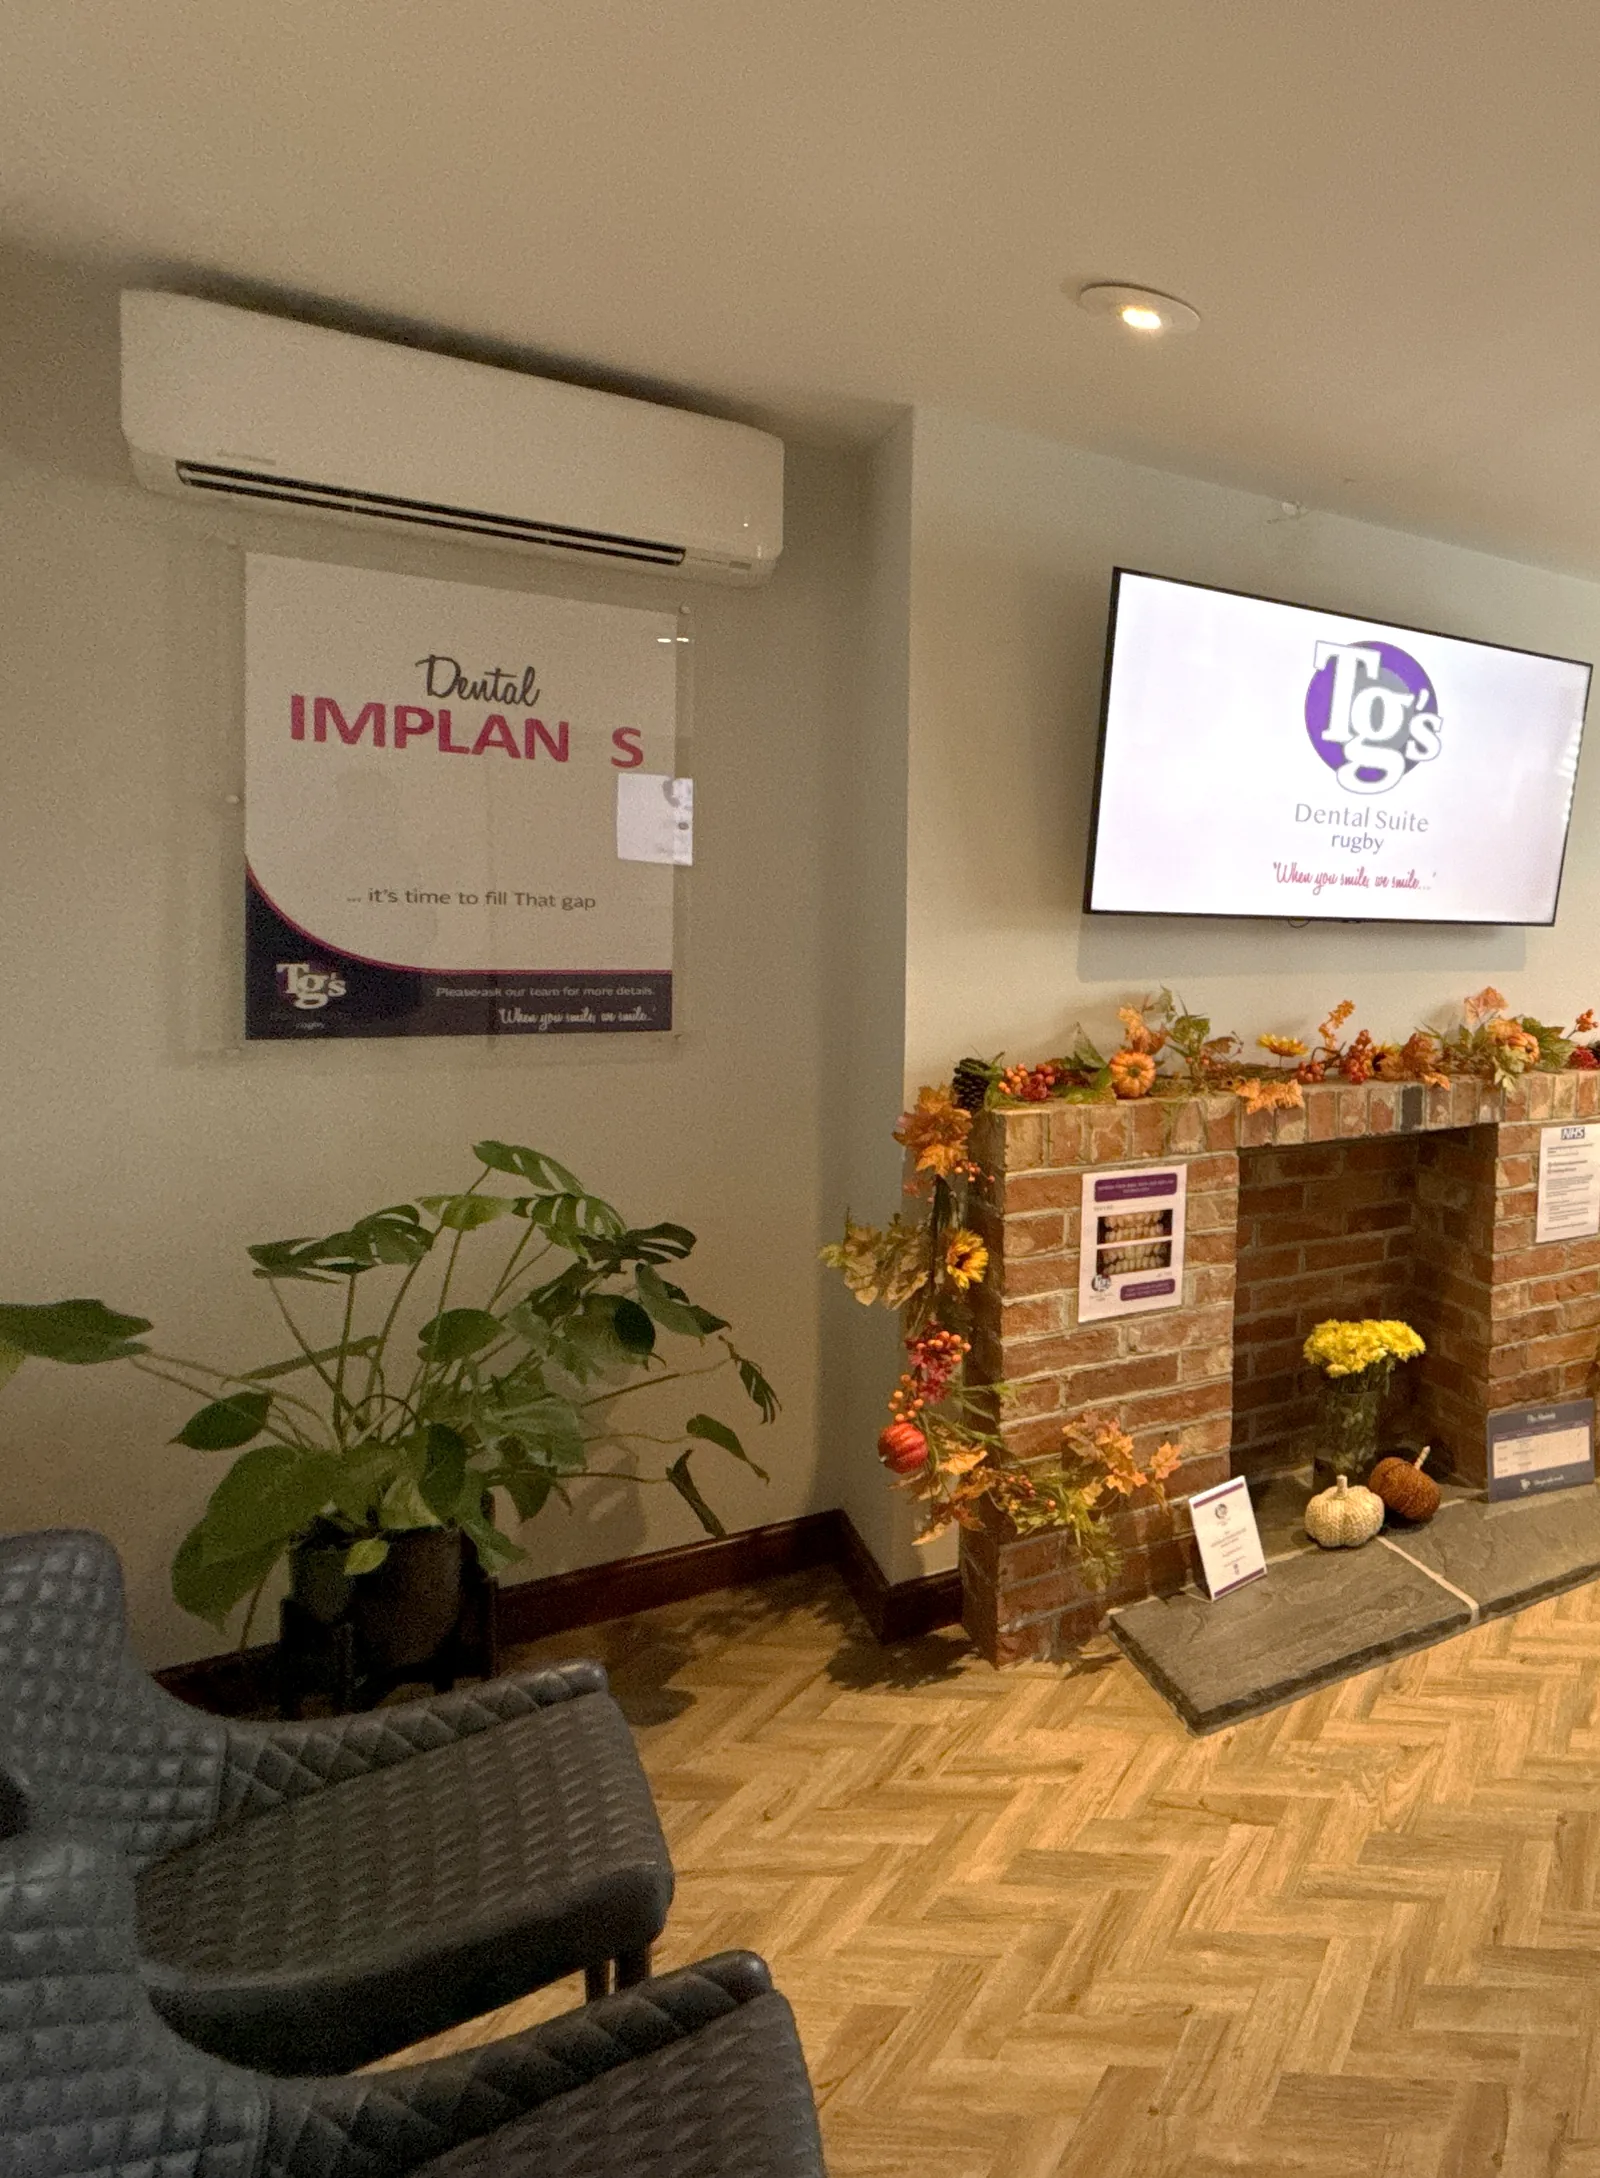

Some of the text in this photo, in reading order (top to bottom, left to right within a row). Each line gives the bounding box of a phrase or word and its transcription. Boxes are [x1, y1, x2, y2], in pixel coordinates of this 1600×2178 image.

[415, 654, 540, 707] Dental
[1313, 640, 1444, 795] Tg's
[1295, 803, 1429, 832] Dental Suite
[1331, 832, 1384, 855] rugby
[1313, 872, 1338, 896] you
[1374, 875, 1390, 888] we
[368, 887, 399, 904] it's
[405, 887, 451, 905] time
[458, 891, 479, 905] to
[485, 890, 507, 906] fill
[514, 892, 556, 908] That
[561, 894, 596, 911] gap
[276, 963, 347, 1010] Tg's
[505, 988, 525, 998] our
[529, 987, 560, 997] team
[563, 986, 580, 996] for
[583, 987, 614, 997] more
[1562, 1127, 1584, 1139] NHS
